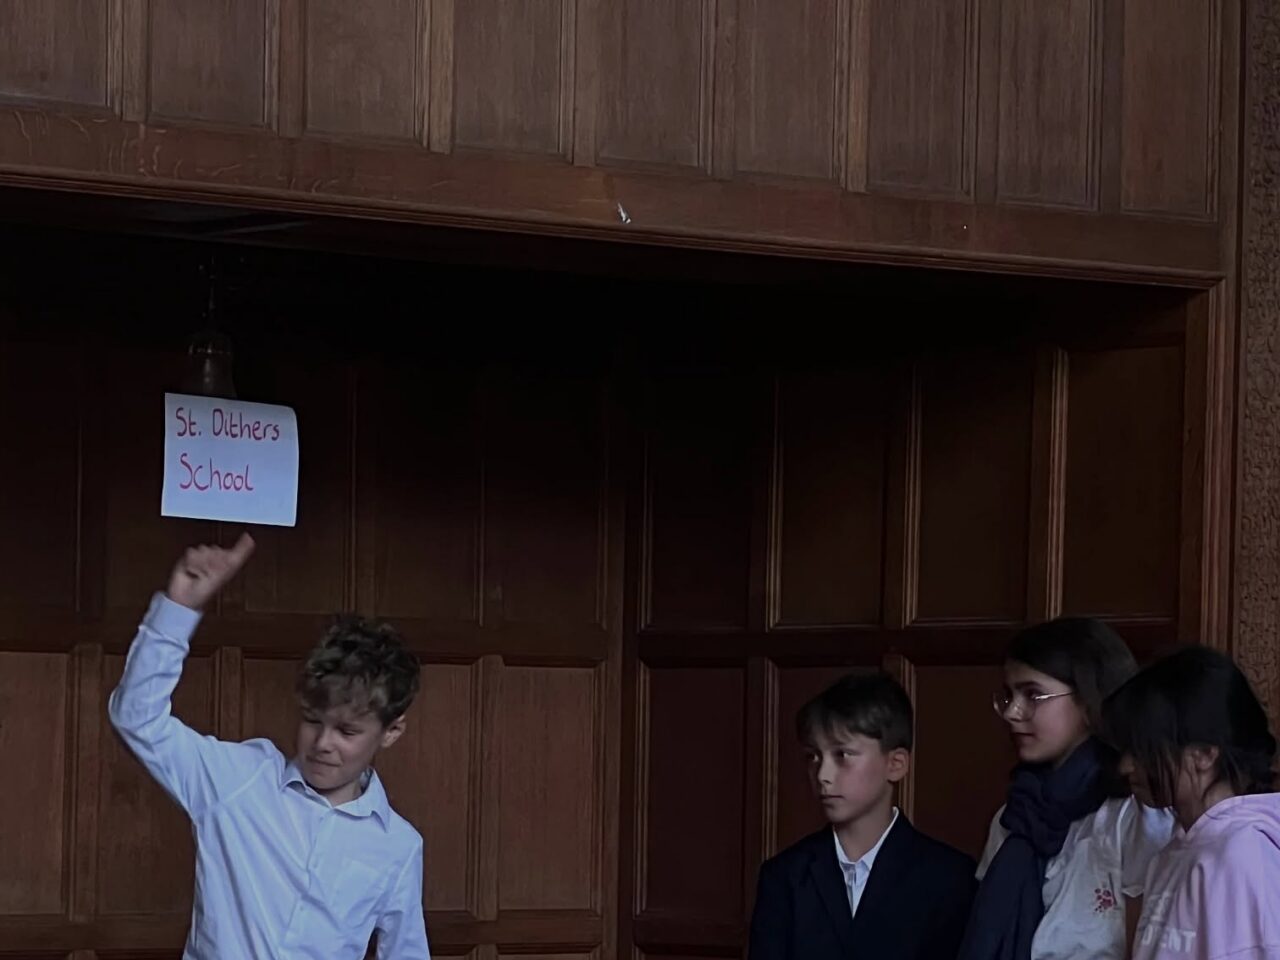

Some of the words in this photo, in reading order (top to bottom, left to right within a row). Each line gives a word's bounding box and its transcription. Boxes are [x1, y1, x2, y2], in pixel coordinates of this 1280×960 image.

[175, 406, 202, 437] St.
[211, 408, 280, 441] Dithers
[179, 452, 254, 491] School
